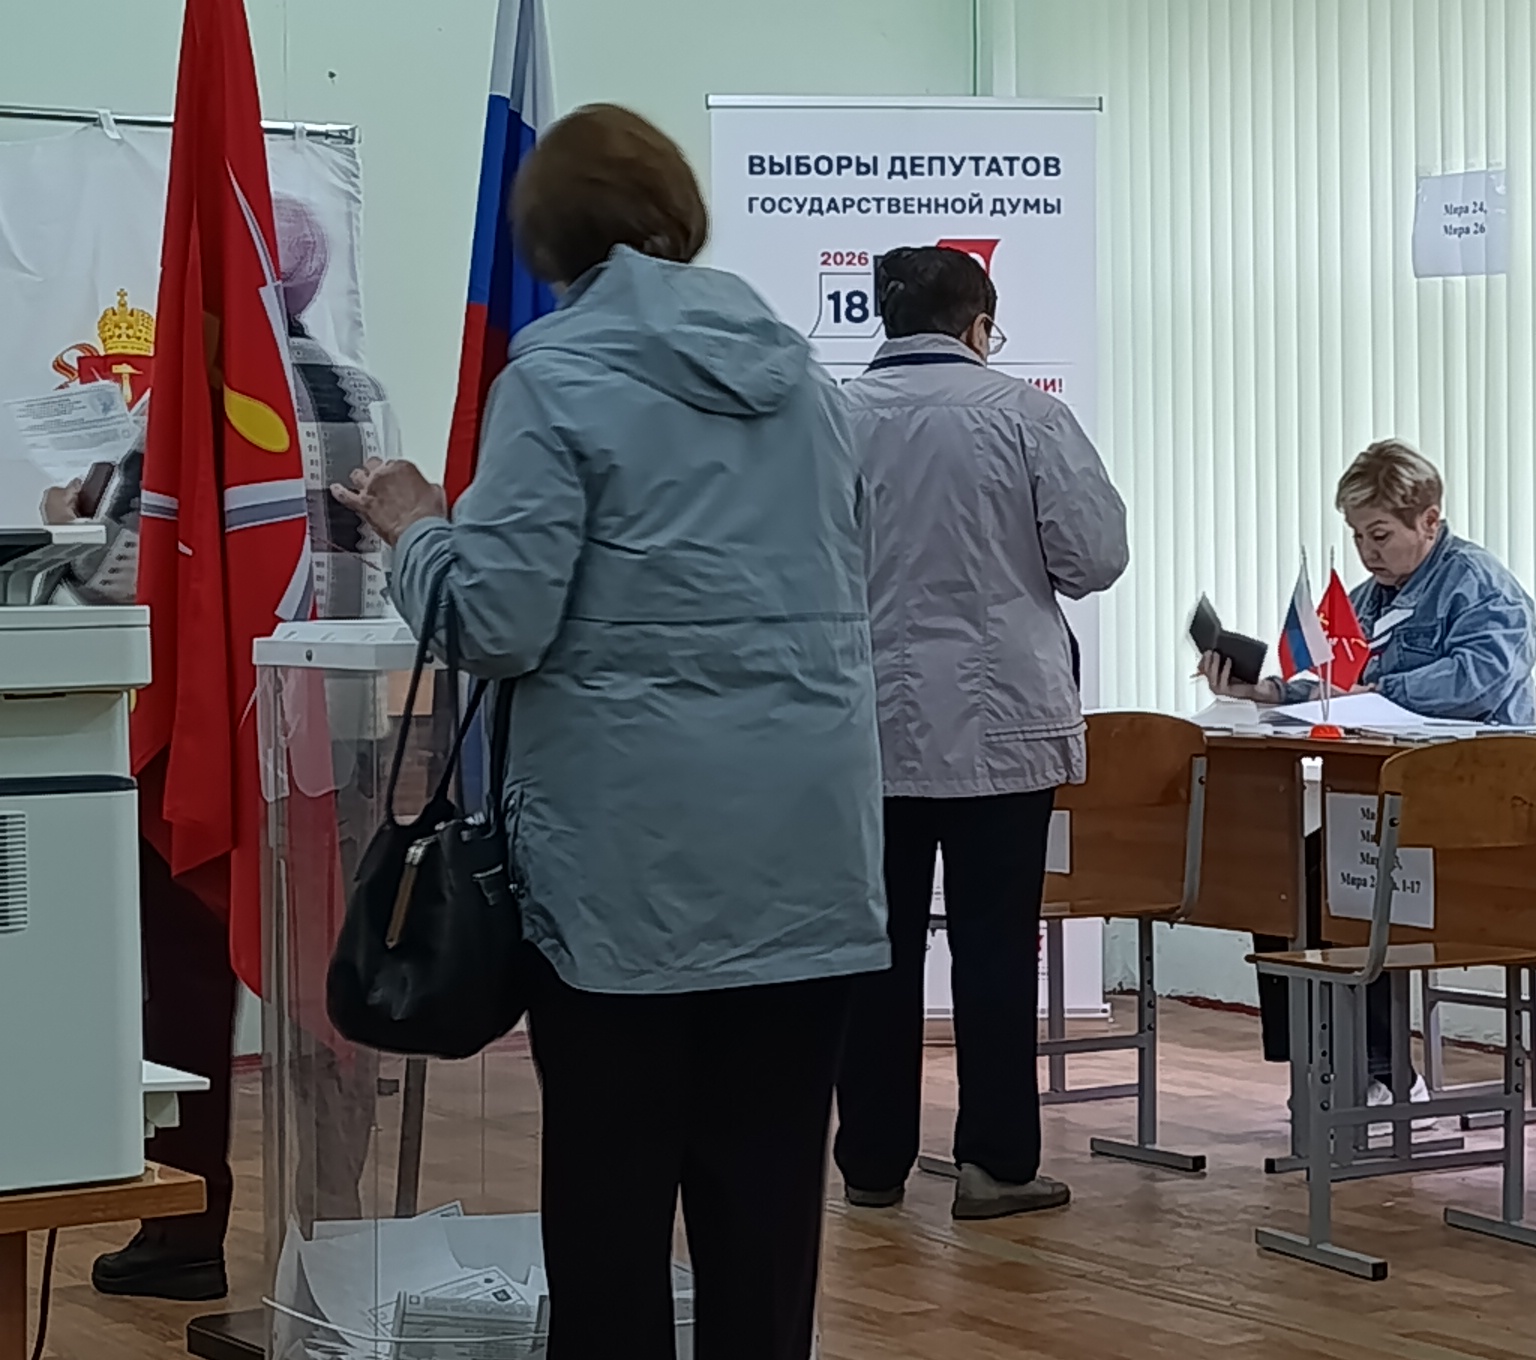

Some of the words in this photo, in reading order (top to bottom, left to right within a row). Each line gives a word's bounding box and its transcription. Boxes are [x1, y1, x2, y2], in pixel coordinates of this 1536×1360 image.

[748, 154, 878, 176] ВЫБОРЫ
[887, 155, 1062, 180] ДЕПУТАТОВ
[747, 192, 984, 217] ГОСУДАРСТВЕННОЙ
[989, 197, 1062, 217] ДУМЫ
[820, 251, 869, 266] 2026
[827, 289, 870, 324] 18
[1340, 872, 1367, 890] Мира
[1402, 879, 1421, 894] 1-17
